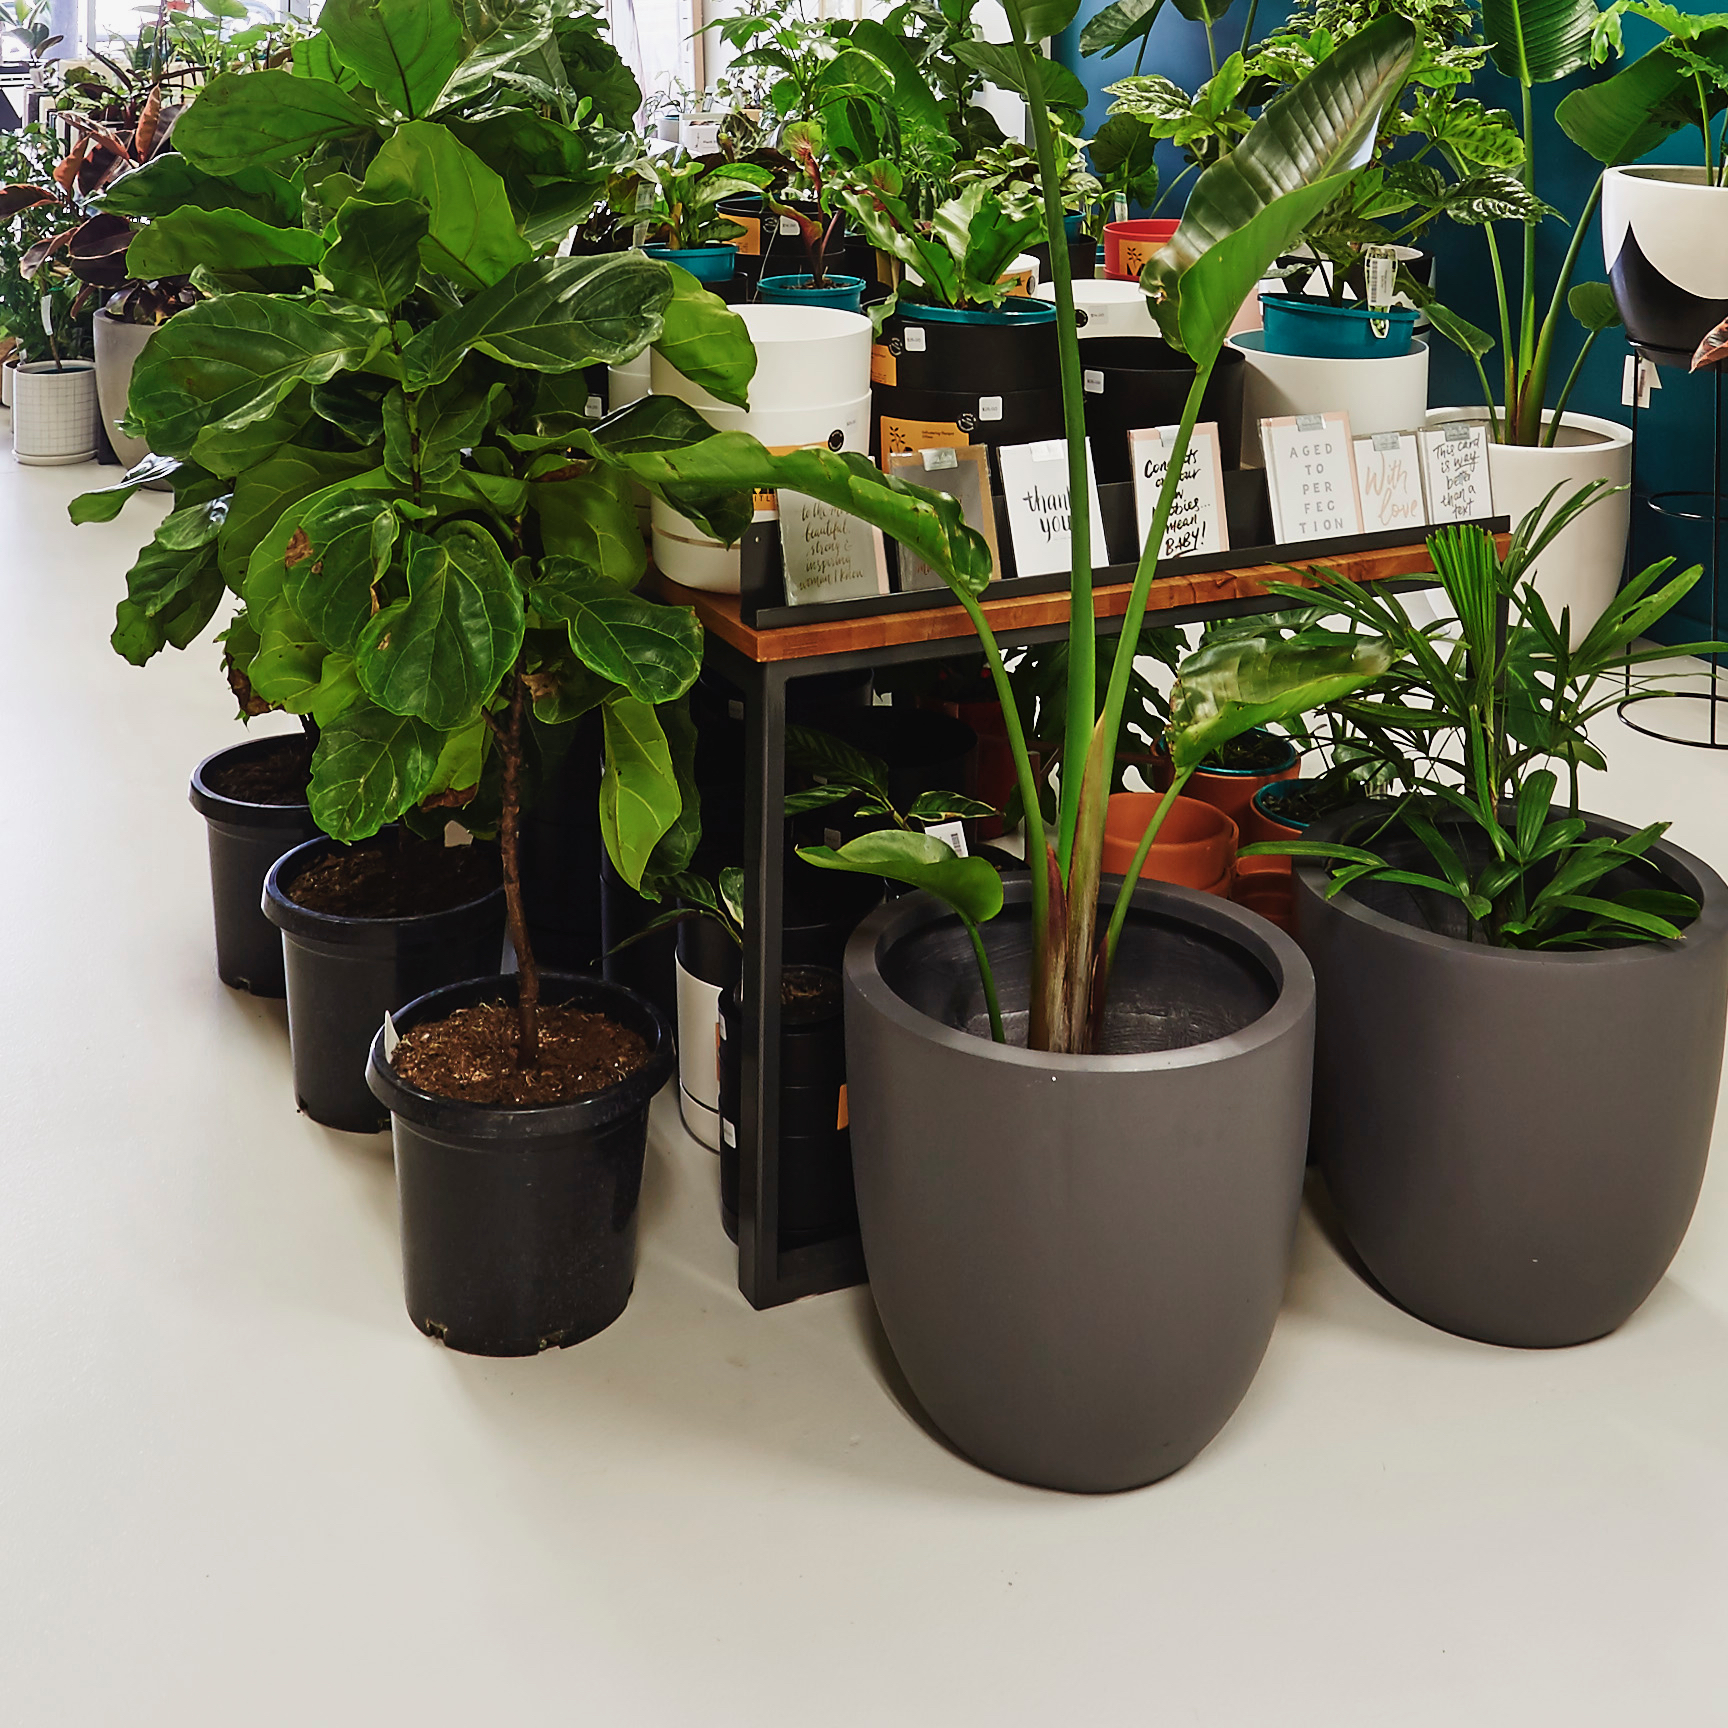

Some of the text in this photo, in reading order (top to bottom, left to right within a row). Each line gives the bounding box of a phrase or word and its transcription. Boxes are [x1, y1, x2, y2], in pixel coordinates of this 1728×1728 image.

[1289, 442, 1334, 459] AGED
[1433, 433, 1481, 460] This card
[1305, 463, 1324, 476] TO
[1365, 451, 1408, 496] With
[1441, 451, 1480, 474] is way
[1022, 485, 1071, 514] than
[1303, 481, 1333, 495] PER
[1440, 484, 1476, 507] than a
[1304, 500, 1335, 514] FEC
[1377, 487, 1418, 526] love
[1452, 500, 1474, 519] text
[1299, 518, 1344, 534] TION
[1165, 521, 1207, 556] BABY!
